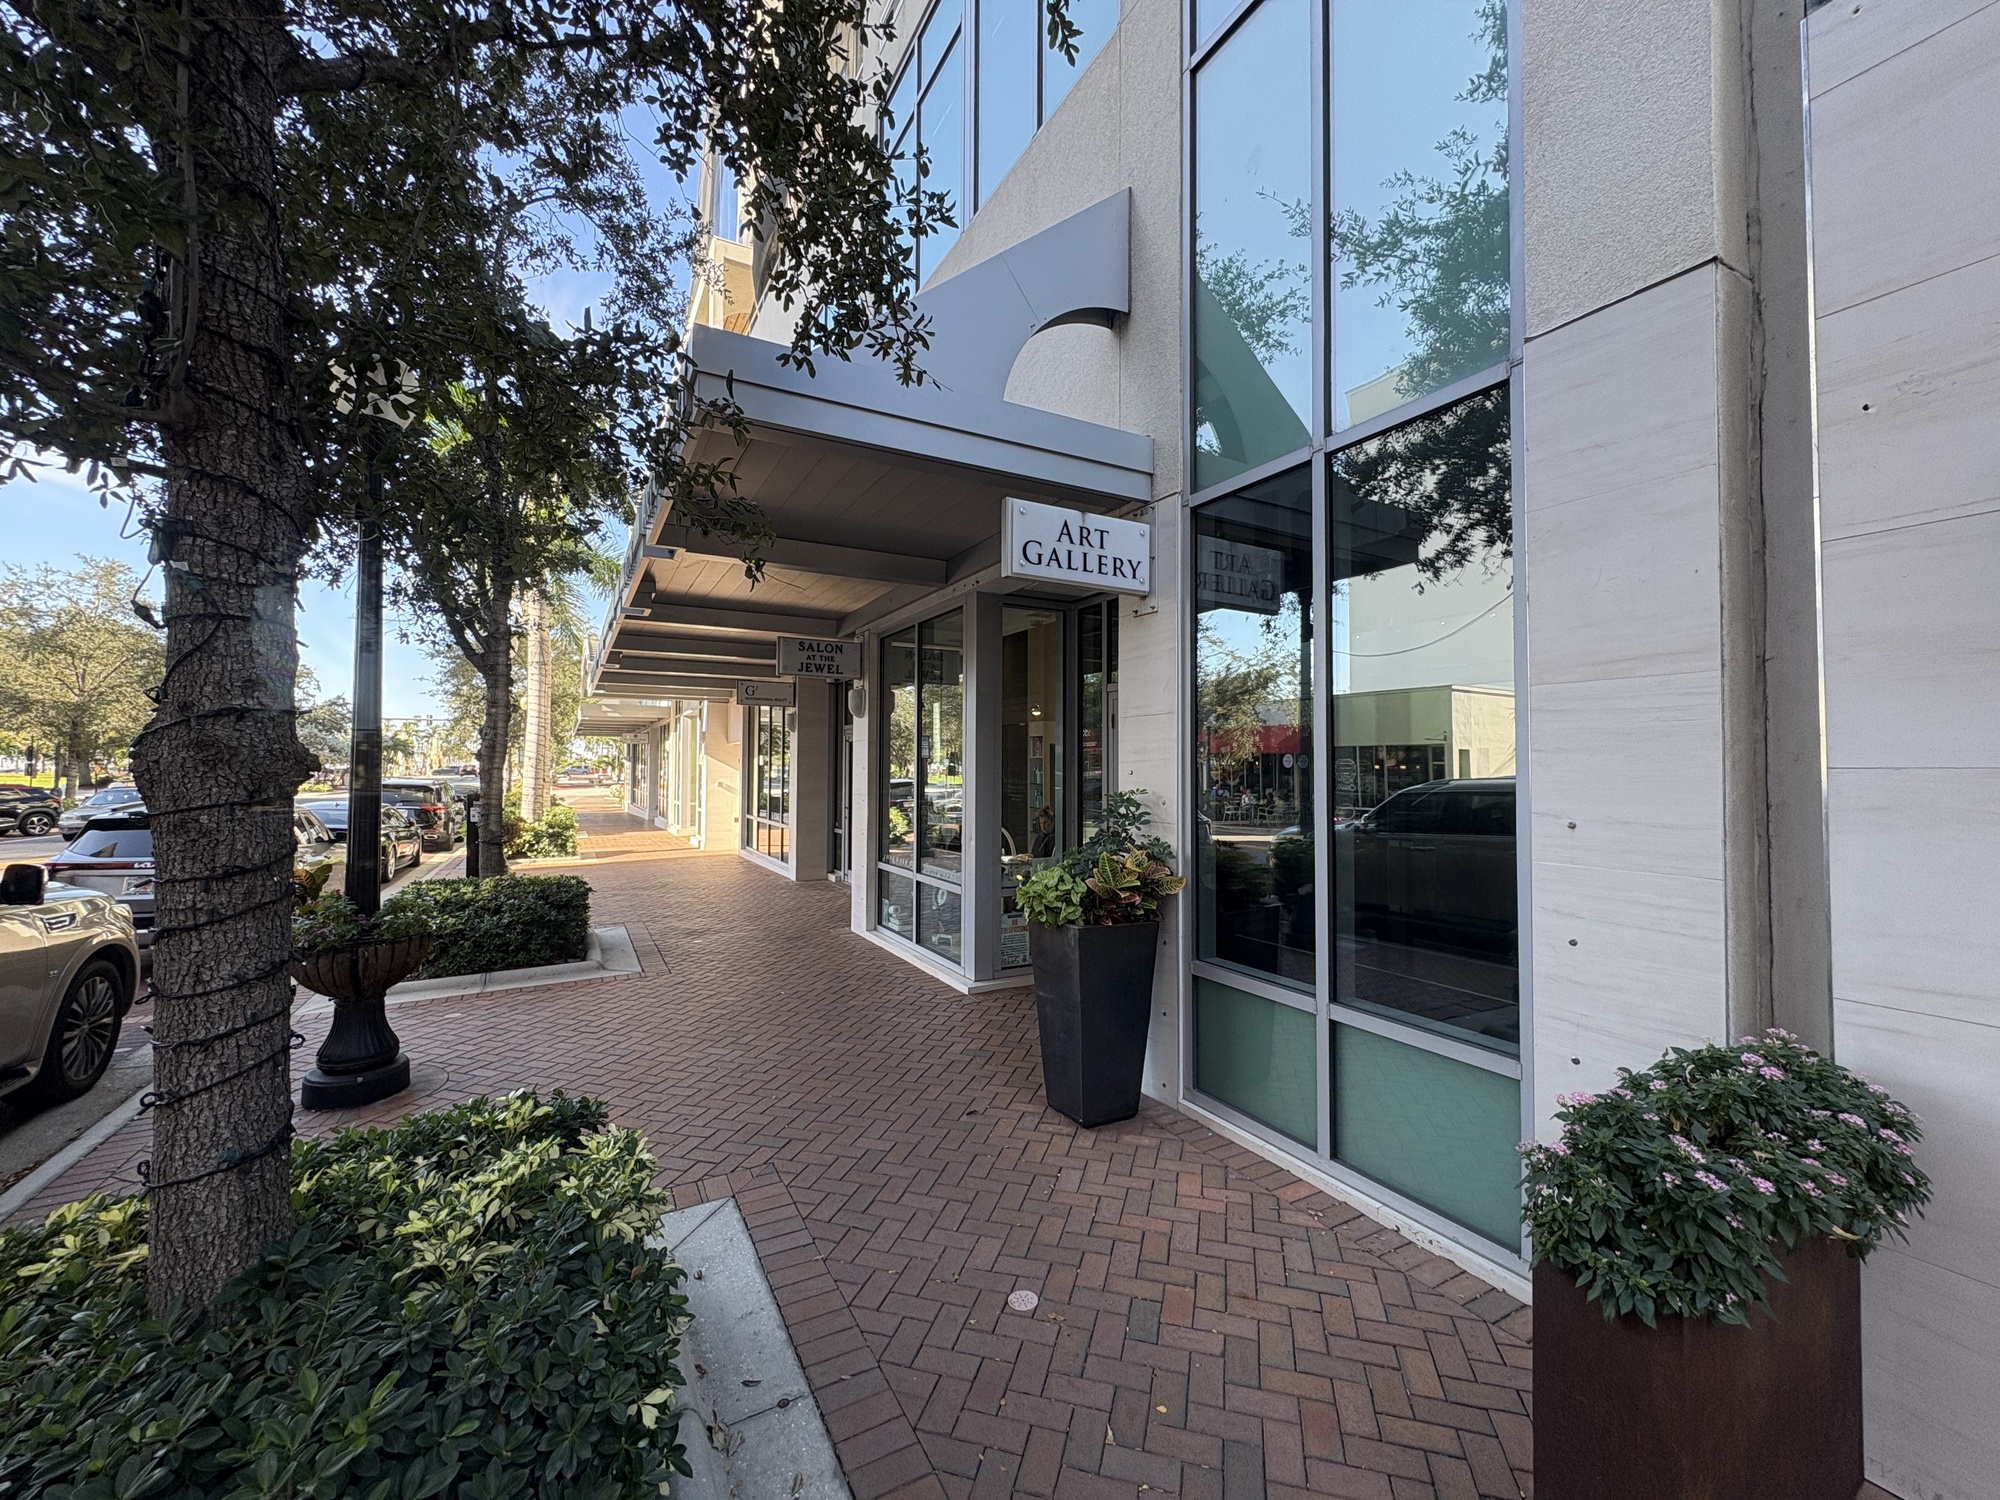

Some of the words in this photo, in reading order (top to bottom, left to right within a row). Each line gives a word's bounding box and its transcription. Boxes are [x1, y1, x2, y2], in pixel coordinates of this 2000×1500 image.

[1055, 518, 1110, 551] ART
[1022, 539, 1143, 580] GALLERY
[798, 641, 844, 655] SALON
[819, 655, 836, 663] THE
[797, 662, 844, 675] JEWEL
